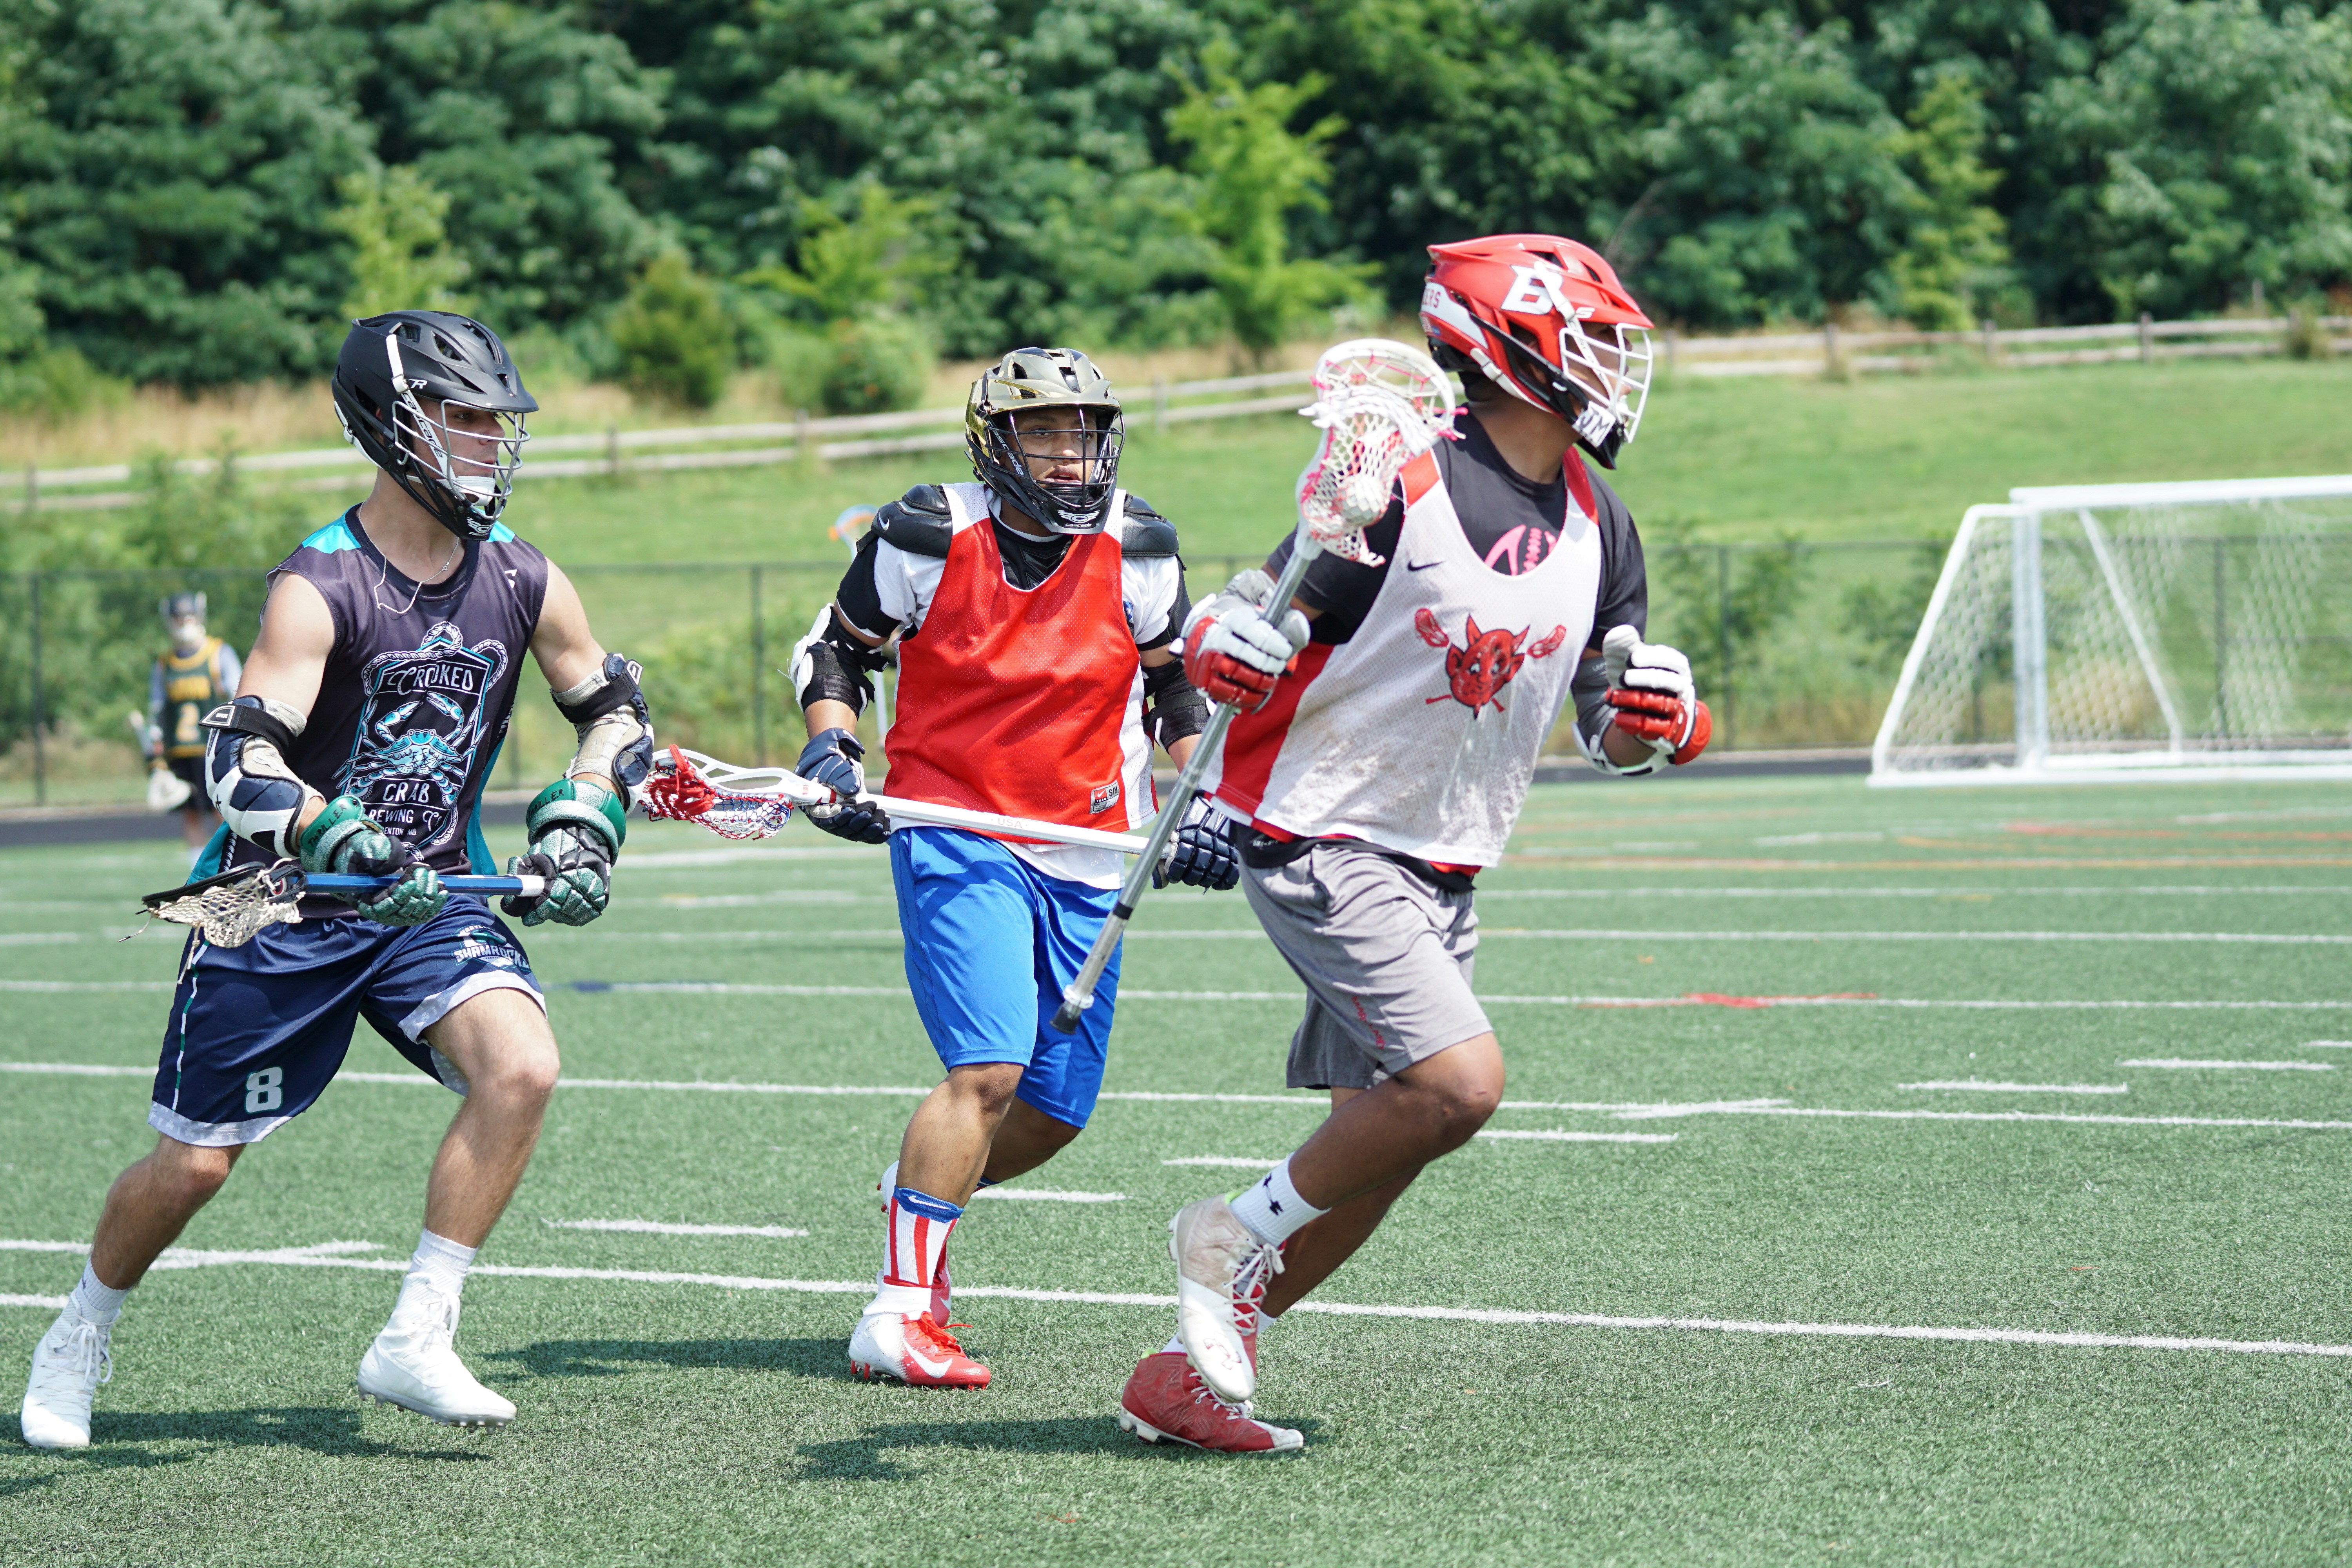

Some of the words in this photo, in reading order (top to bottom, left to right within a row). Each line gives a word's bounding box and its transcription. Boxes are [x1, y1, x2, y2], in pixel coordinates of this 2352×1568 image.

[1501, 265, 1563, 315] B
[408, 379, 428, 389] R
[403, 392, 443, 458] cacade
[986, 420, 1024, 475] cascade
[387, 664, 474, 695] CROOKED
[383, 782, 430, 803] CRAB
[1109, 785, 1118, 797] S/M
[367, 809, 414, 824] REWING
[997, 817, 1023, 829] USA
[383, 827, 404, 836] ENTON
[1351, 995, 1386, 1050] MARLAND
[244, 1065, 284, 1114] 8
